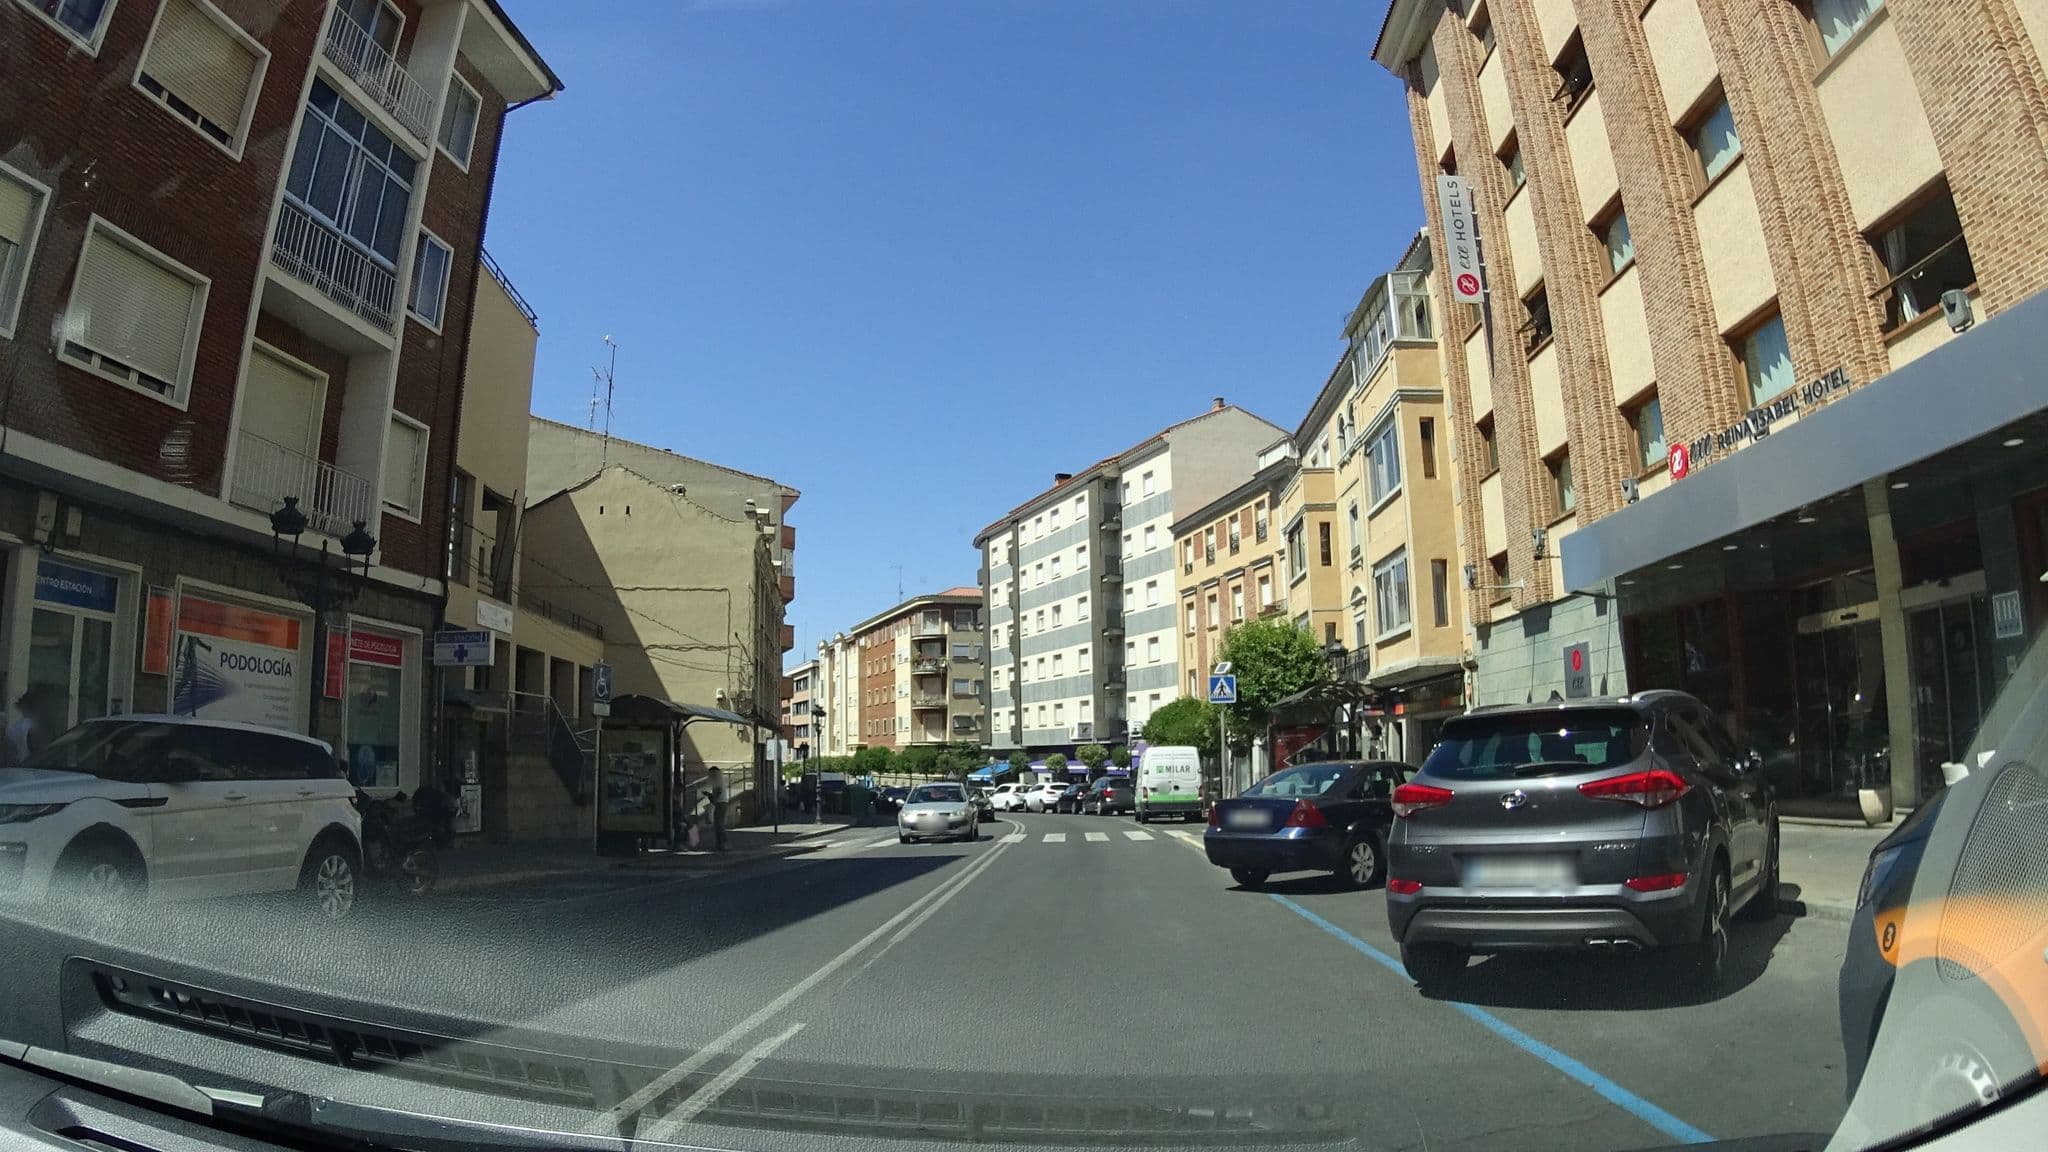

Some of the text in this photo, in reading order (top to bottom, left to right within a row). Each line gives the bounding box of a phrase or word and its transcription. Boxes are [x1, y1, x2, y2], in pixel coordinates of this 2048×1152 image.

[1447, 180, 1466, 241] HOTELS
[1717, 417, 1752, 449] REINA
[1802, 367, 1850, 404] HOTEL
[220, 652, 292, 677] PODOLOGÍA
[1165, 765, 1190, 773] MILAR
